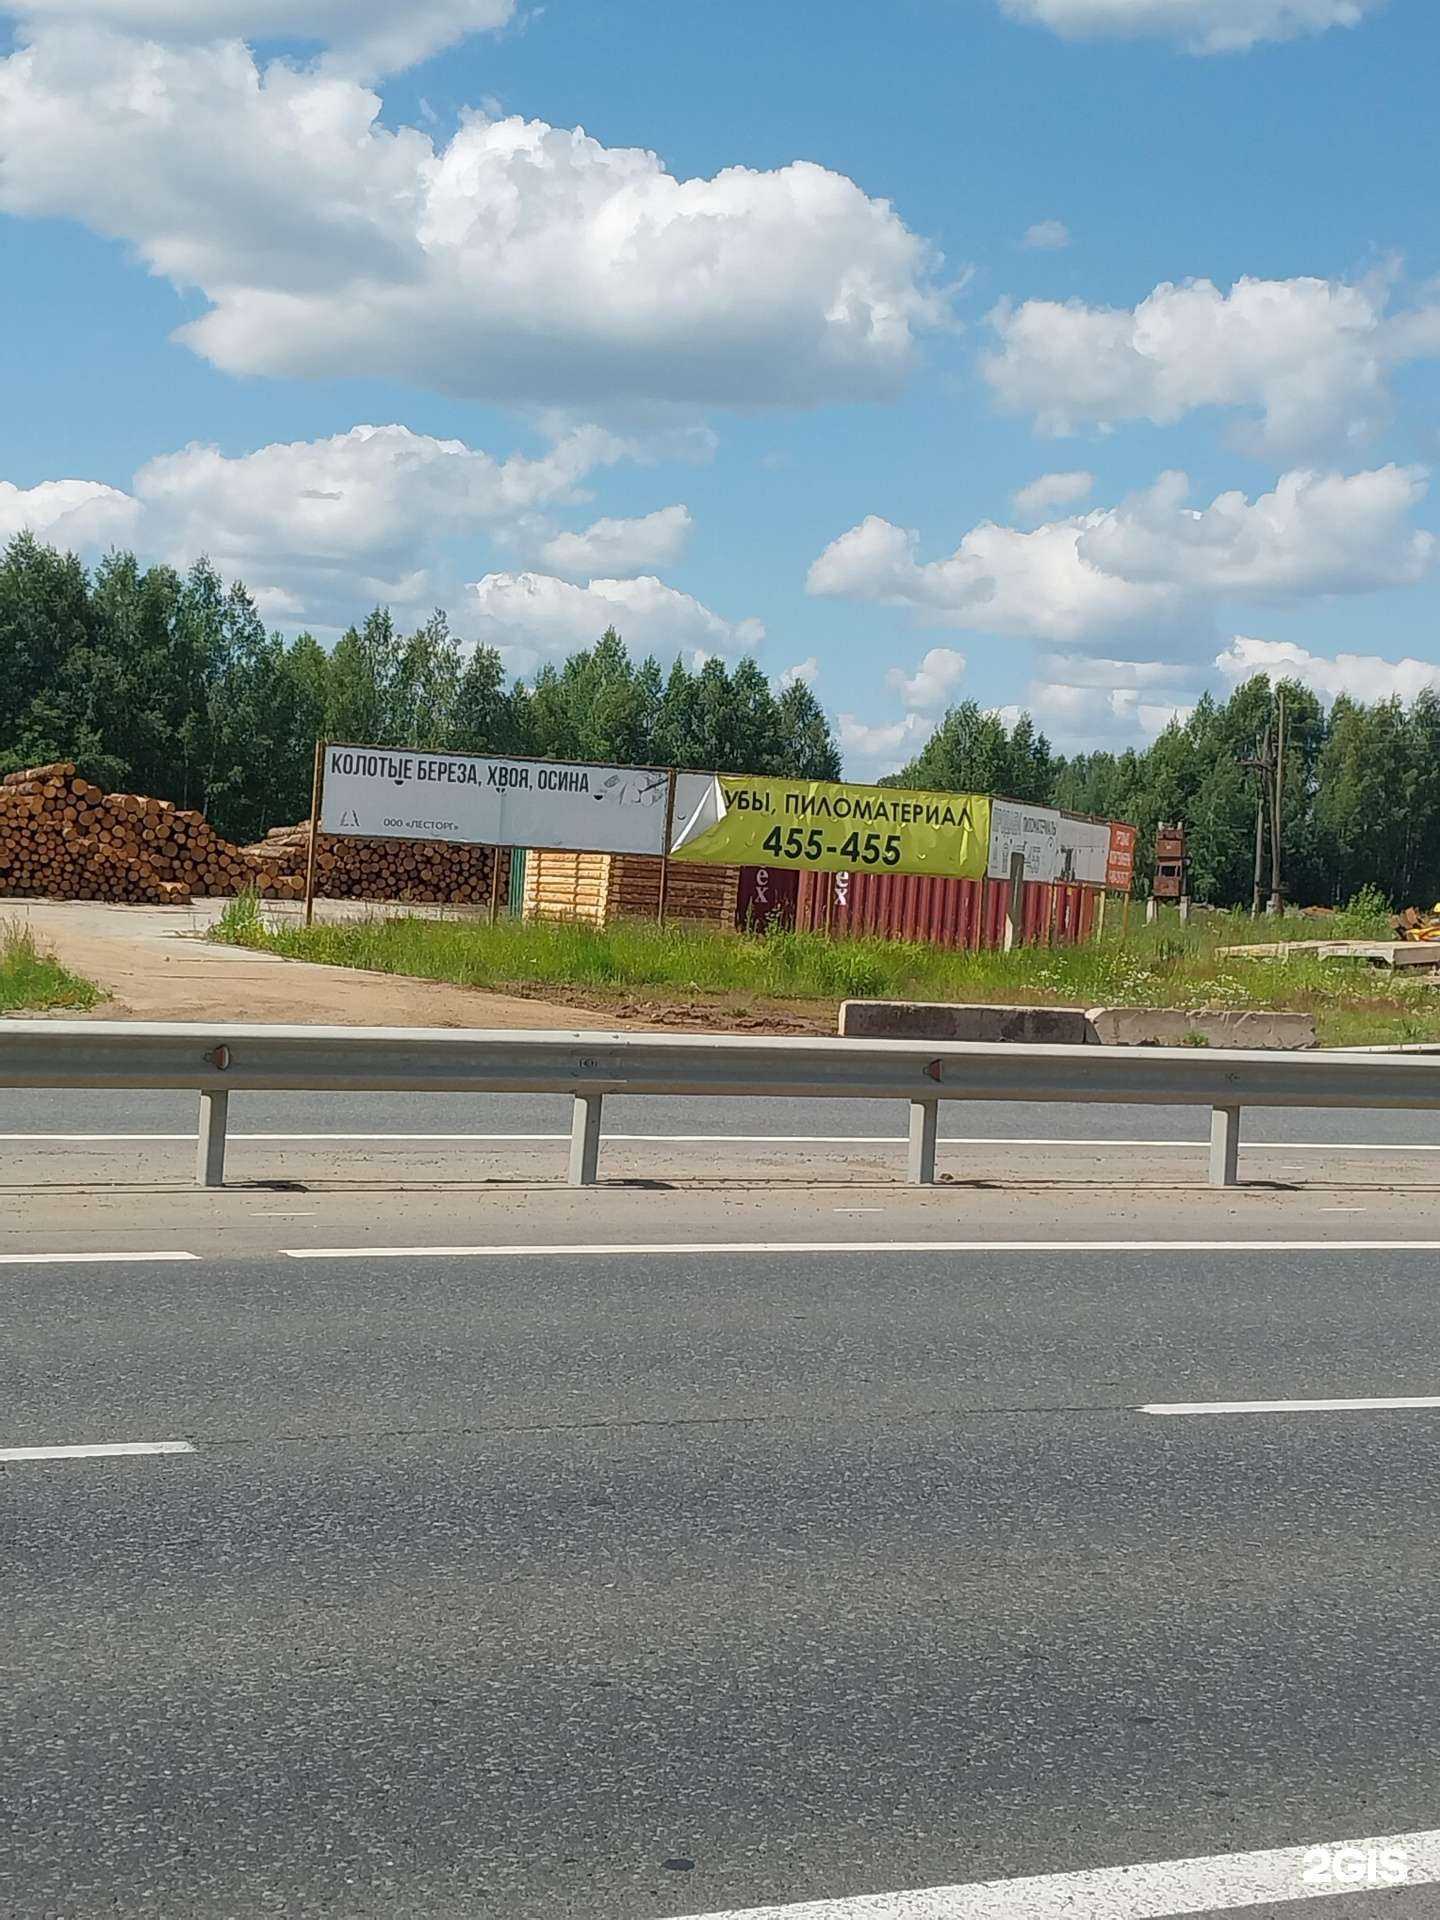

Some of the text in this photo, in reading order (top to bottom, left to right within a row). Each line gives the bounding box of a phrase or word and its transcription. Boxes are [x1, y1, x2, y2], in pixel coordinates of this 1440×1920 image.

[331, 752, 589, 792] КОЛОТЫЕ БЕРЕЗА, ХВОЯ, ОСИНА
[383, 818, 403, 828] ООО
[785, 794, 973, 827] ПИЛОМАТЕРИАЛ
[762, 826, 902, 866] 455-455
